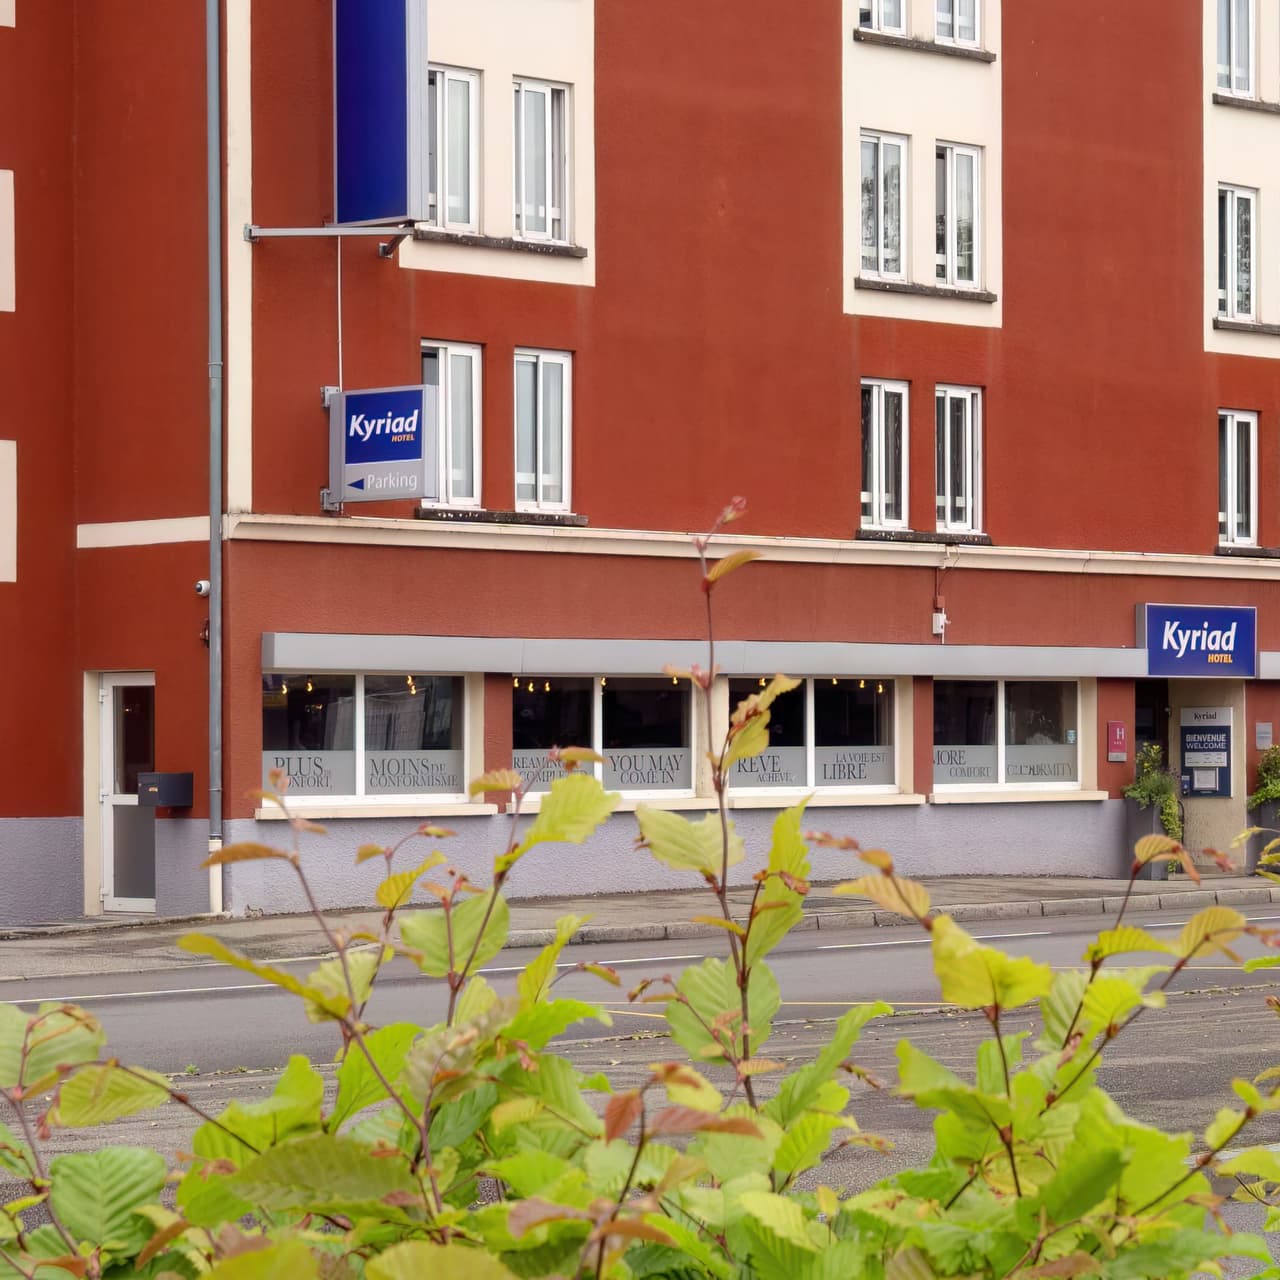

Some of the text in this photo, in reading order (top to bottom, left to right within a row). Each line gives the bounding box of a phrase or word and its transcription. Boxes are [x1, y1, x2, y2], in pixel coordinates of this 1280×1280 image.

[349, 409, 419, 442] Kyriad
[391, 434, 415, 443] HOTEL
[367, 473, 418, 491] Parking
[1162, 621, 1237, 658] Kyriad
[1207, 653, 1233, 664] HOTEL
[1193, 711, 1218, 722] Kyriad
[1185, 734, 1227, 742] BIENVENUE
[1185, 742, 1227, 750] WELCOME
[274, 756, 324, 777] PLUS
[368, 758, 448, 776] MOINS DE
[610, 754, 683, 772] YOU MAY
[620, 770, 675, 784] COME IN
[823, 763, 867, 780] LIBRE
[369, 775, 459, 788] CONFORMISME
